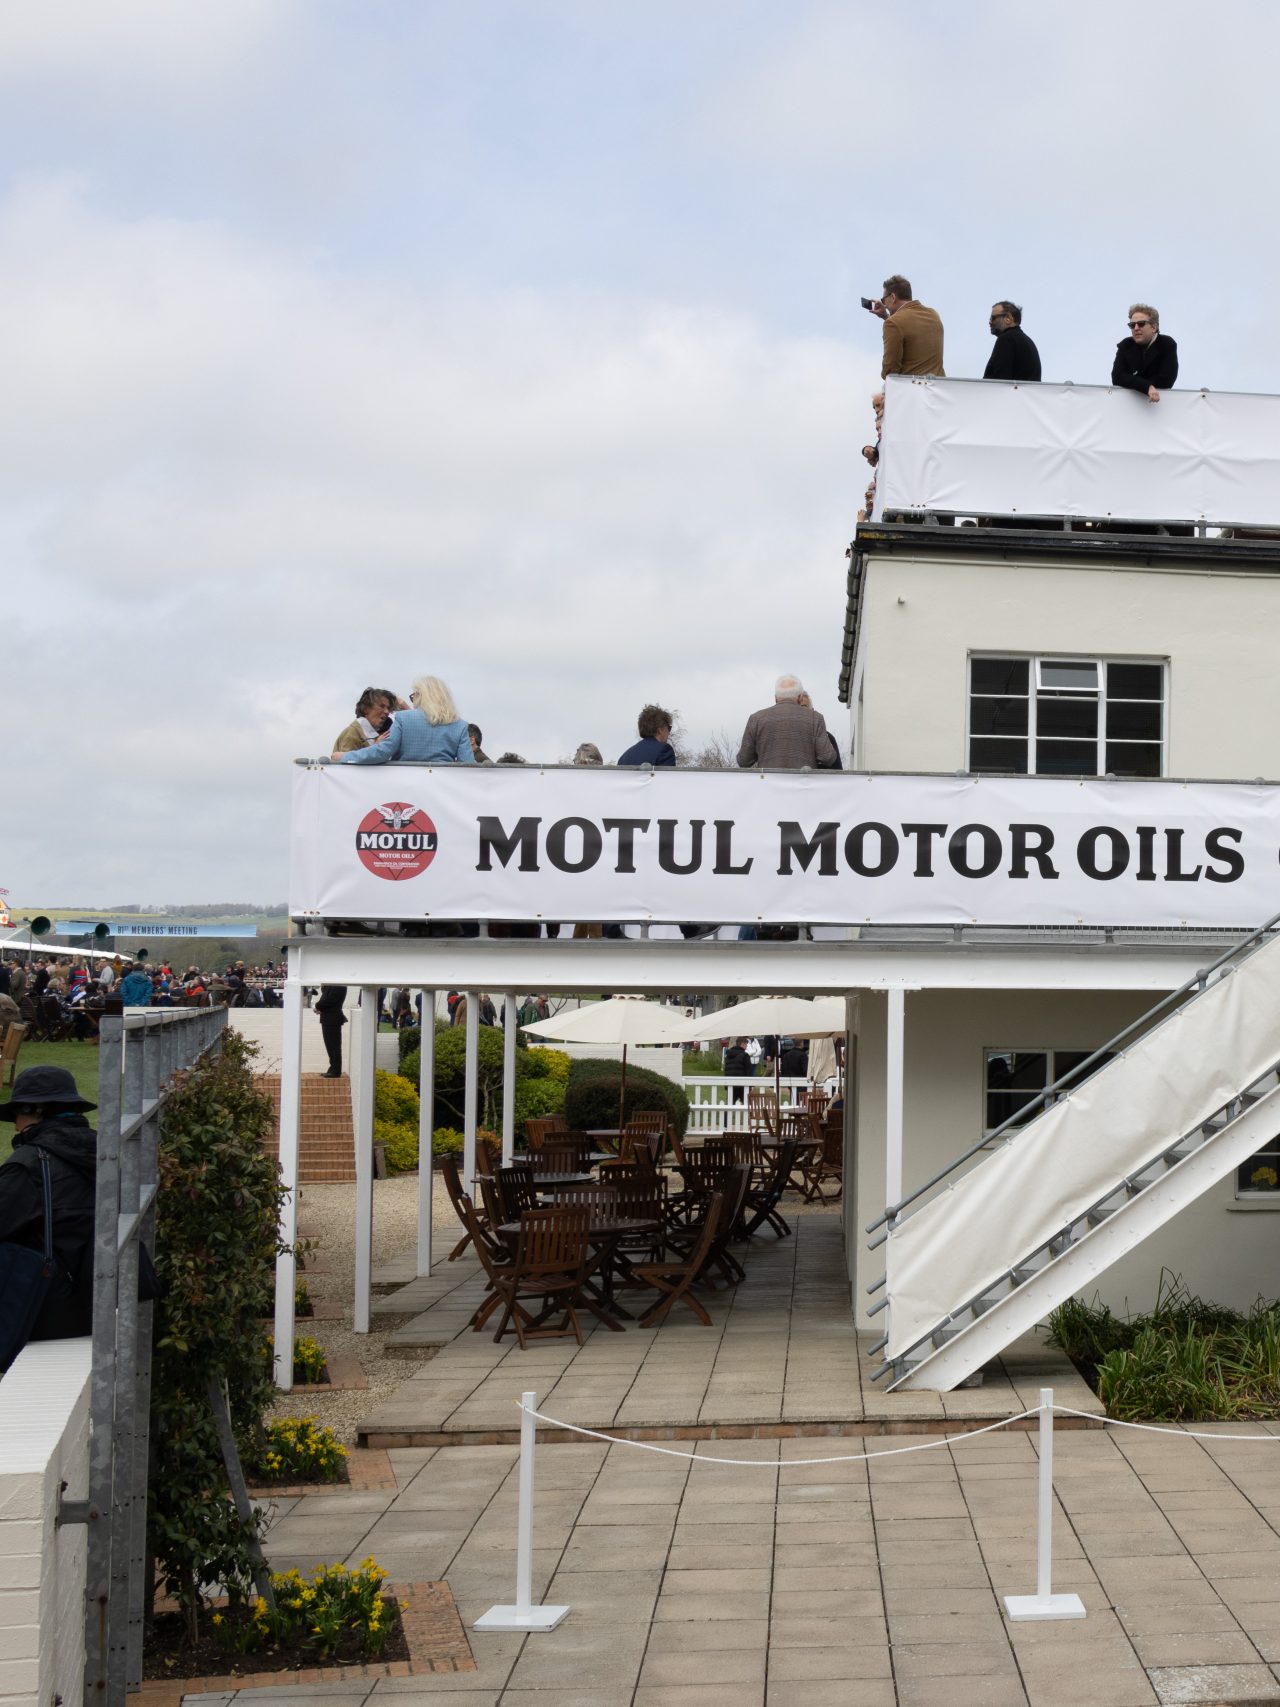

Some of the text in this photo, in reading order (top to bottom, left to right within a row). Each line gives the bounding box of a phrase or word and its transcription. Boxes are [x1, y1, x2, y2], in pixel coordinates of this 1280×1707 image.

[360, 833, 434, 850] MOTUL
[476, 816, 1245, 883] MOTUL MOTOR OILS
[168, 926, 198, 935] MEETING
